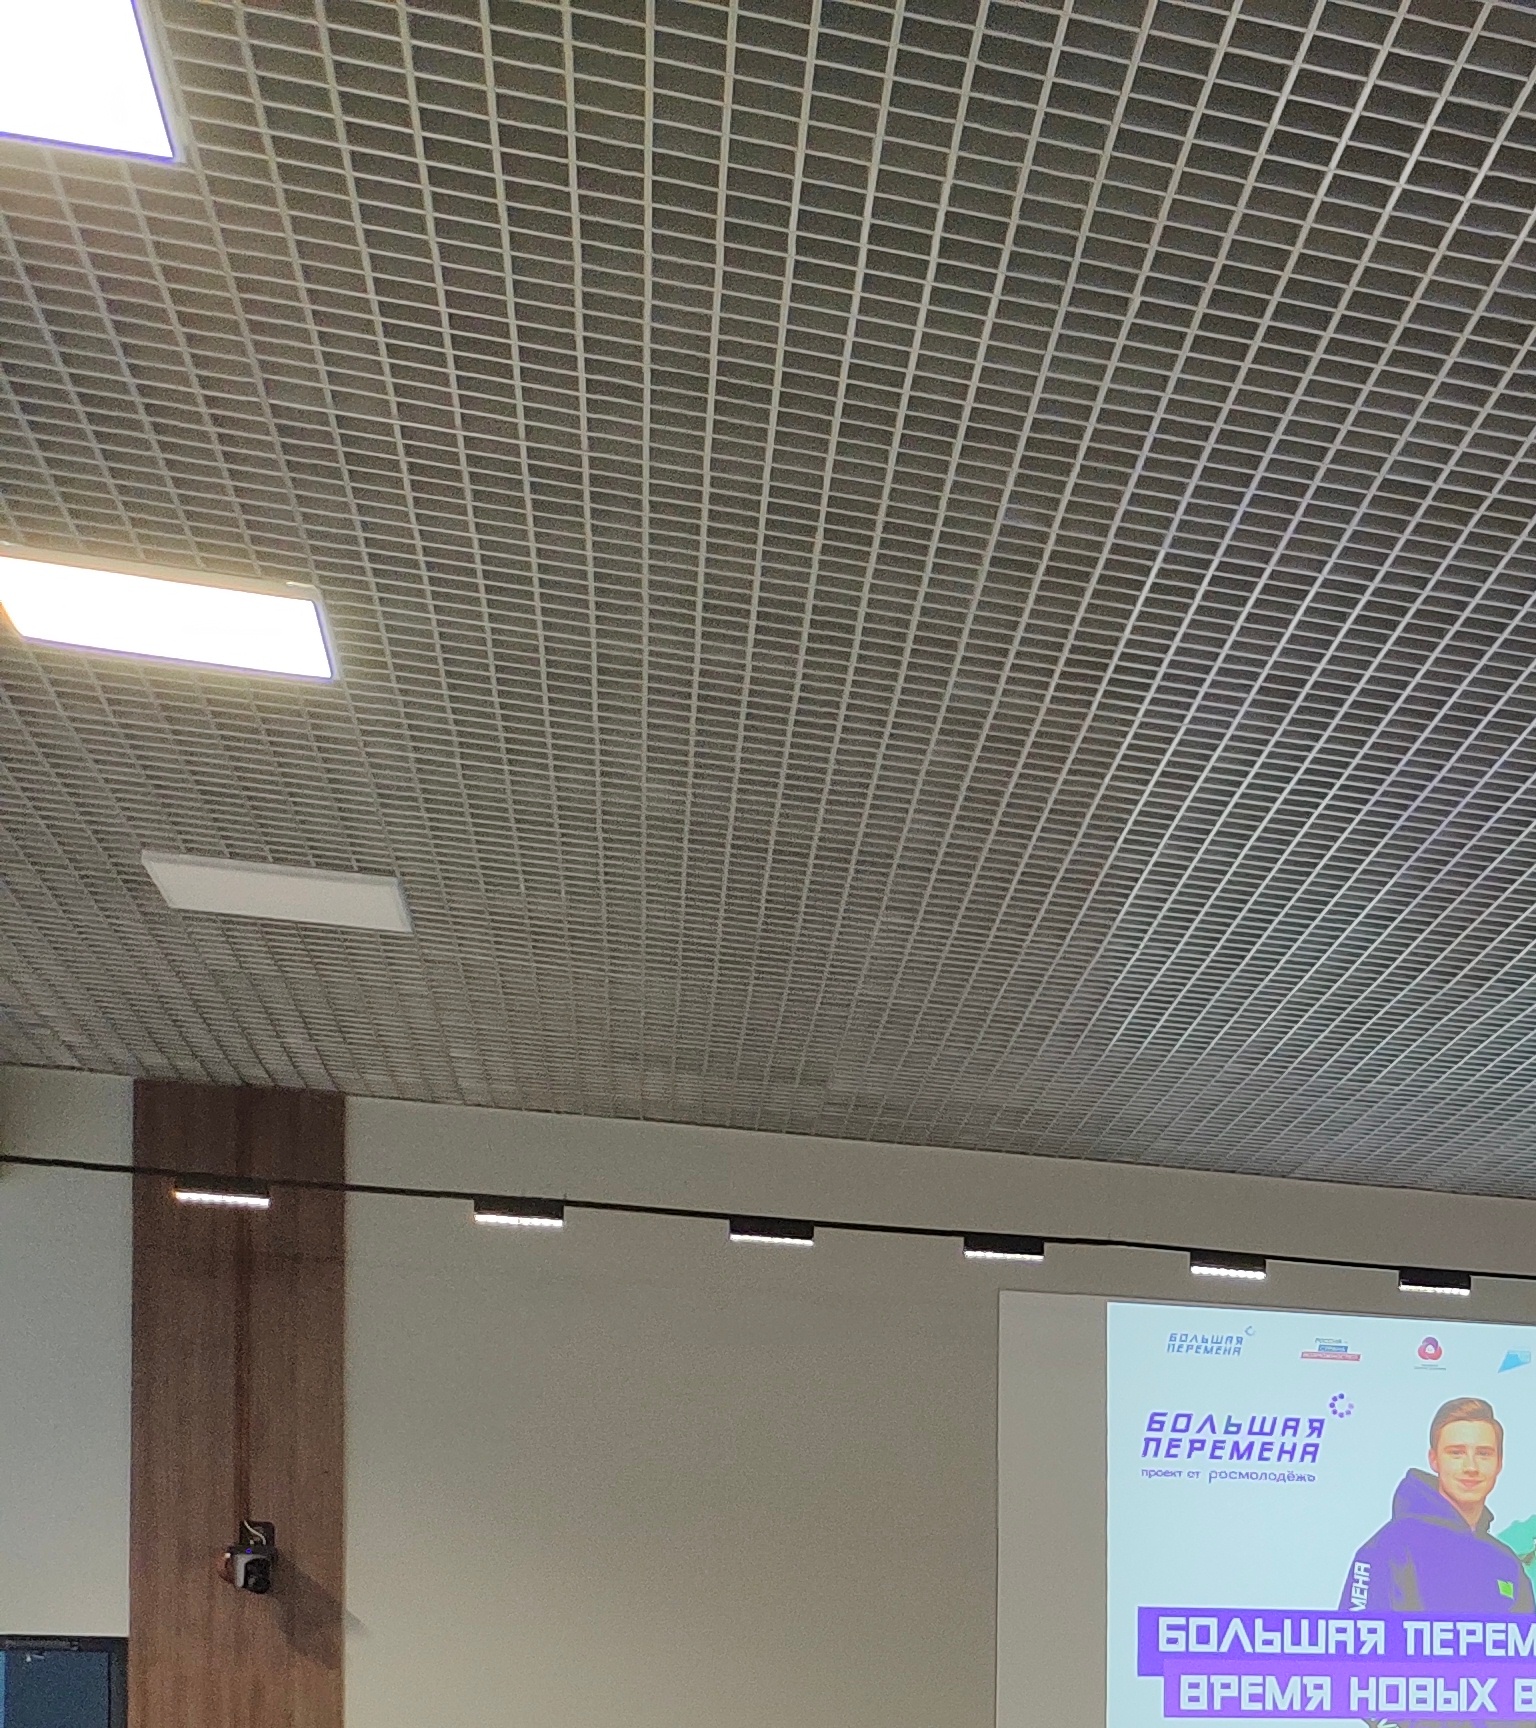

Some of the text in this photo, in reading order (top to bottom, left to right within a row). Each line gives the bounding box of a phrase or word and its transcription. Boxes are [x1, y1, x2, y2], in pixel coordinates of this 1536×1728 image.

[1166, 1343, 1242, 1356] ПЕРЕМЕНА
[1168, 1332, 1244, 1346] БОЛЬШАЯ
[1146, 1411, 1325, 1438] БОЛЬШАЯ
[1141, 1437, 1320, 1463] ПЕРЕМЕНА
[1141, 1468, 1183, 1479] проект
[1158, 1616, 1386, 1655] БОЛЬШАЯ
[1180, 1674, 1331, 1711] ВРЕМЯ
[1350, 1676, 1498, 1712] НОВЫХ
